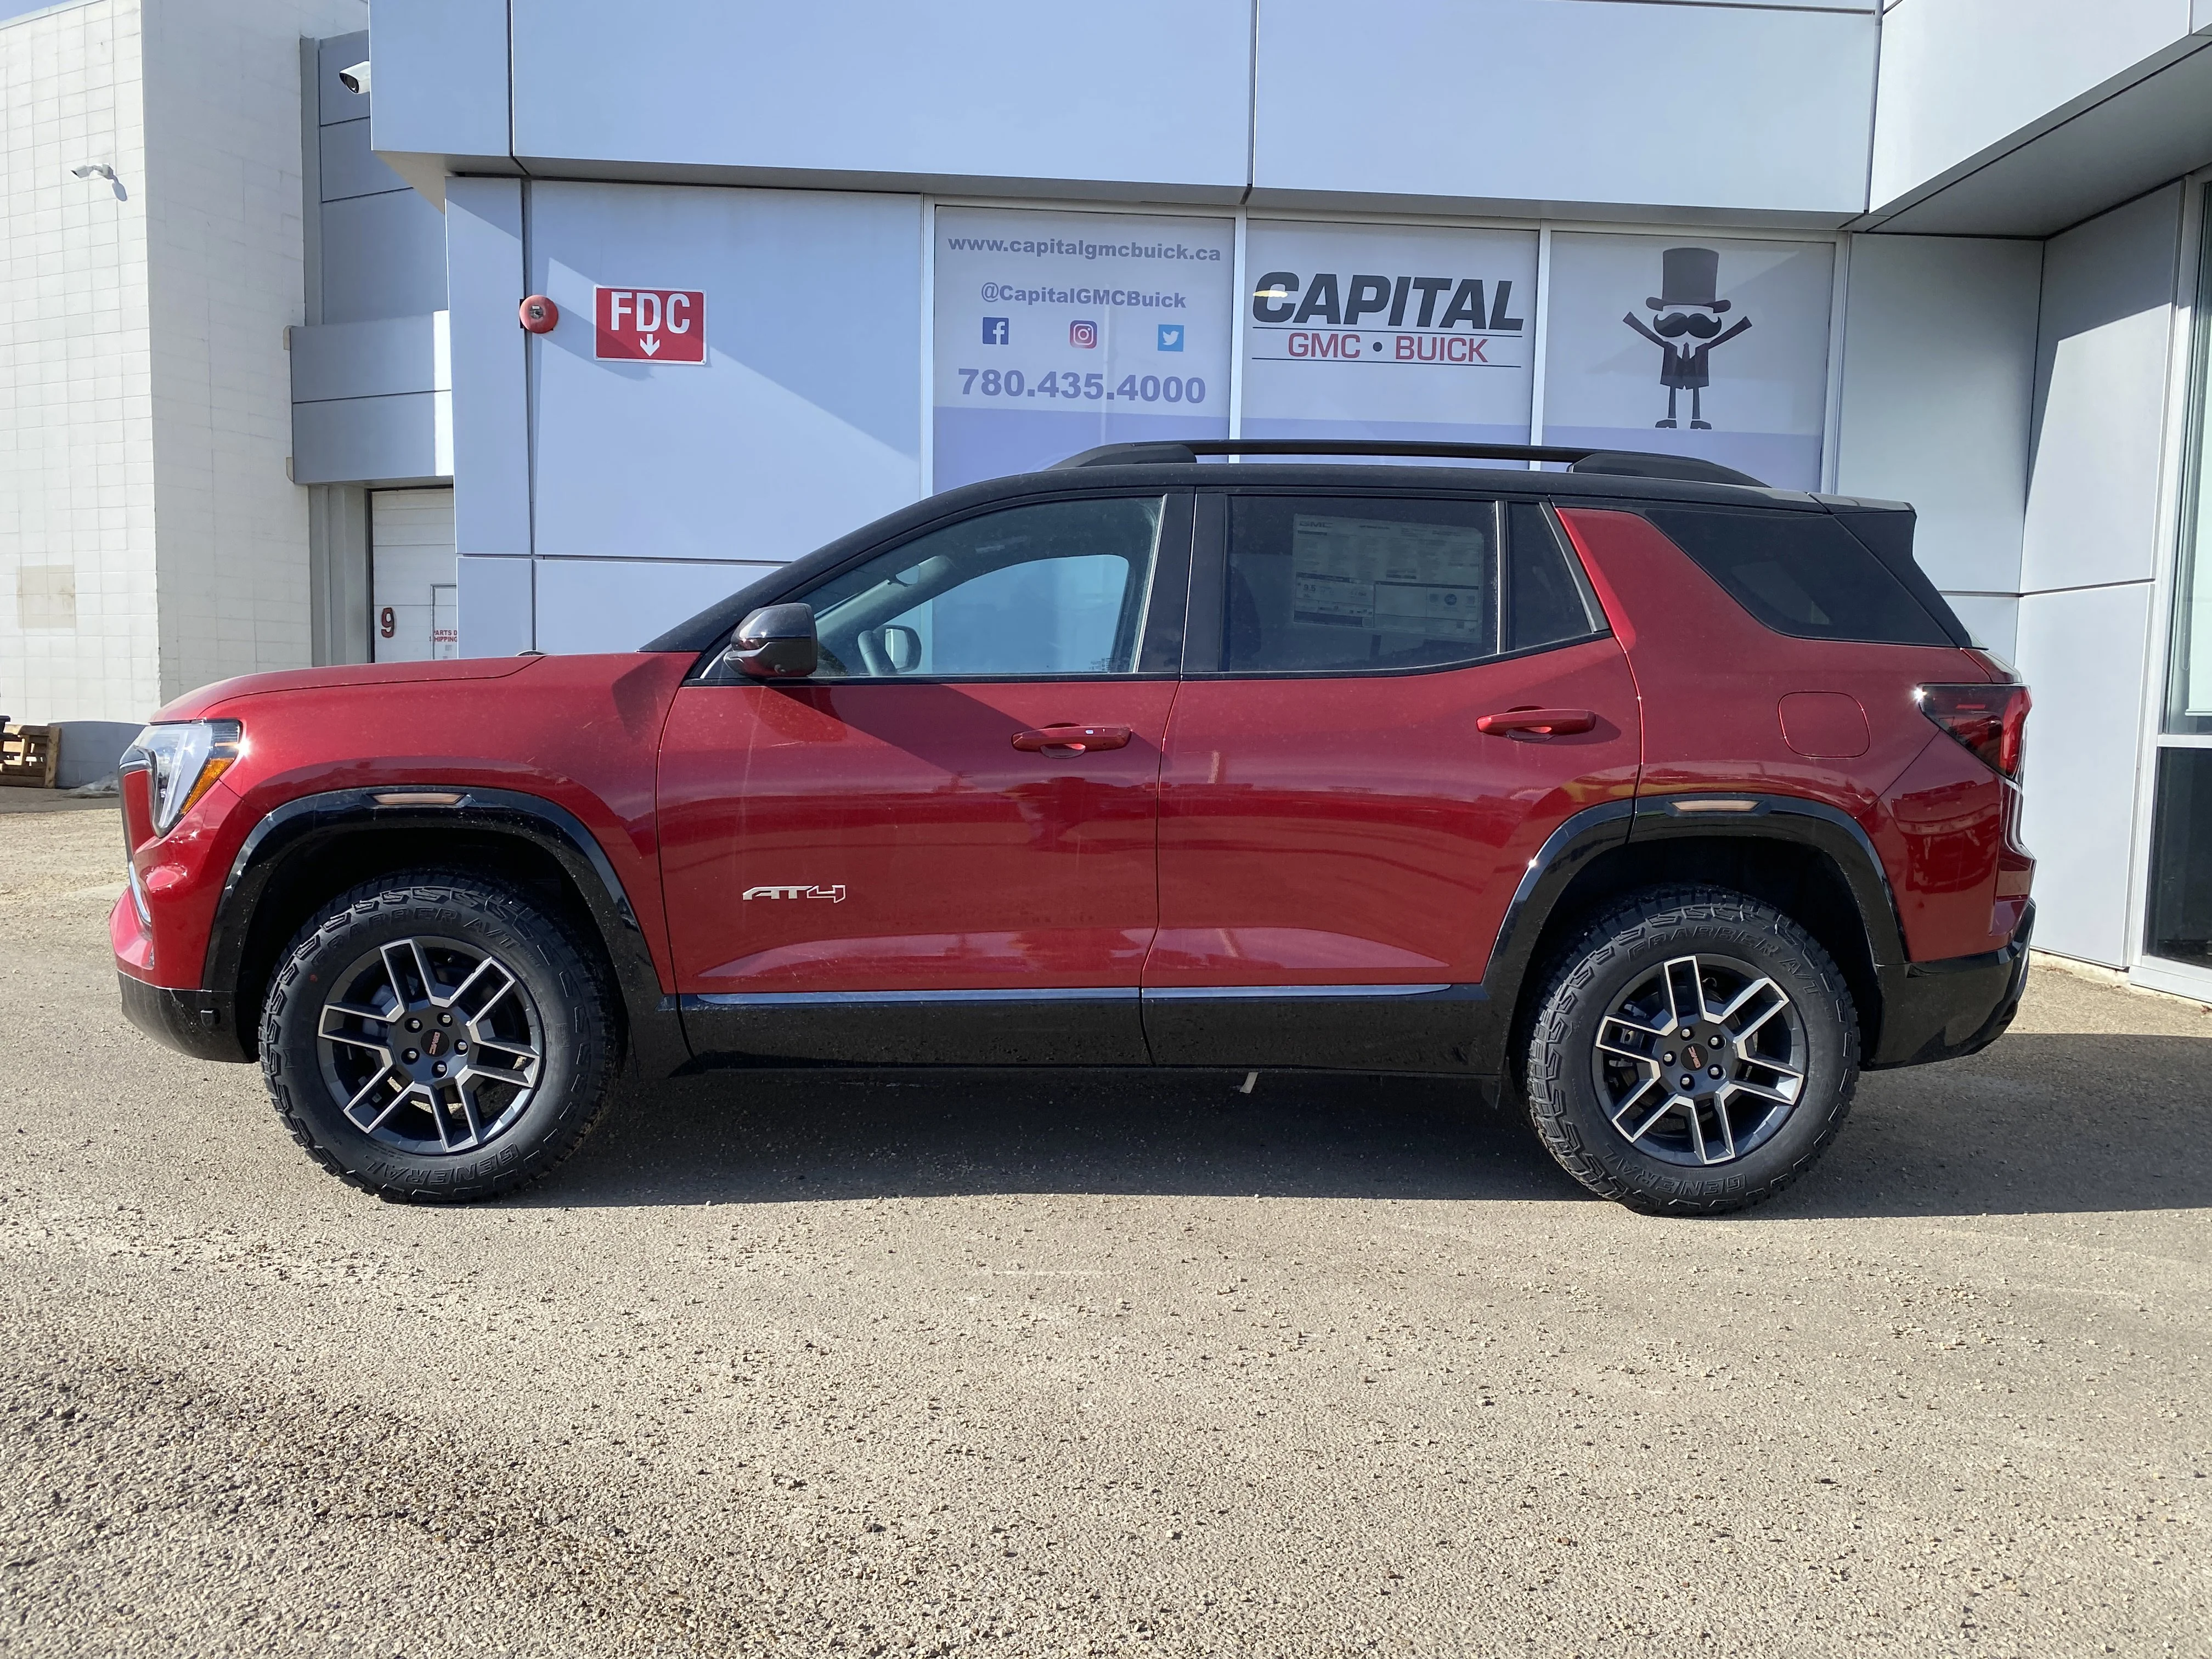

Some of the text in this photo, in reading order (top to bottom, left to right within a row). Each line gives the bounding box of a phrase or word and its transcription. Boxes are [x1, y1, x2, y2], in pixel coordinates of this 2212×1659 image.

[948, 237, 1221, 261] www.capitalgmcbuick.ca
[981, 281, 1187, 308] @CapitalGMCBuick
[1252, 272, 1524, 331] CAPITAL
[611, 291, 690, 334] FDC
[1288, 332, 1489, 363] GMC BUICK
[958, 368, 1206, 404] 780.435.4000
[381, 607, 395, 639] 9
[742, 884, 846, 904] AT4
[363, 1143, 518, 1185] GENERAL
[1602, 1143, 1745, 1197] GENERAL
